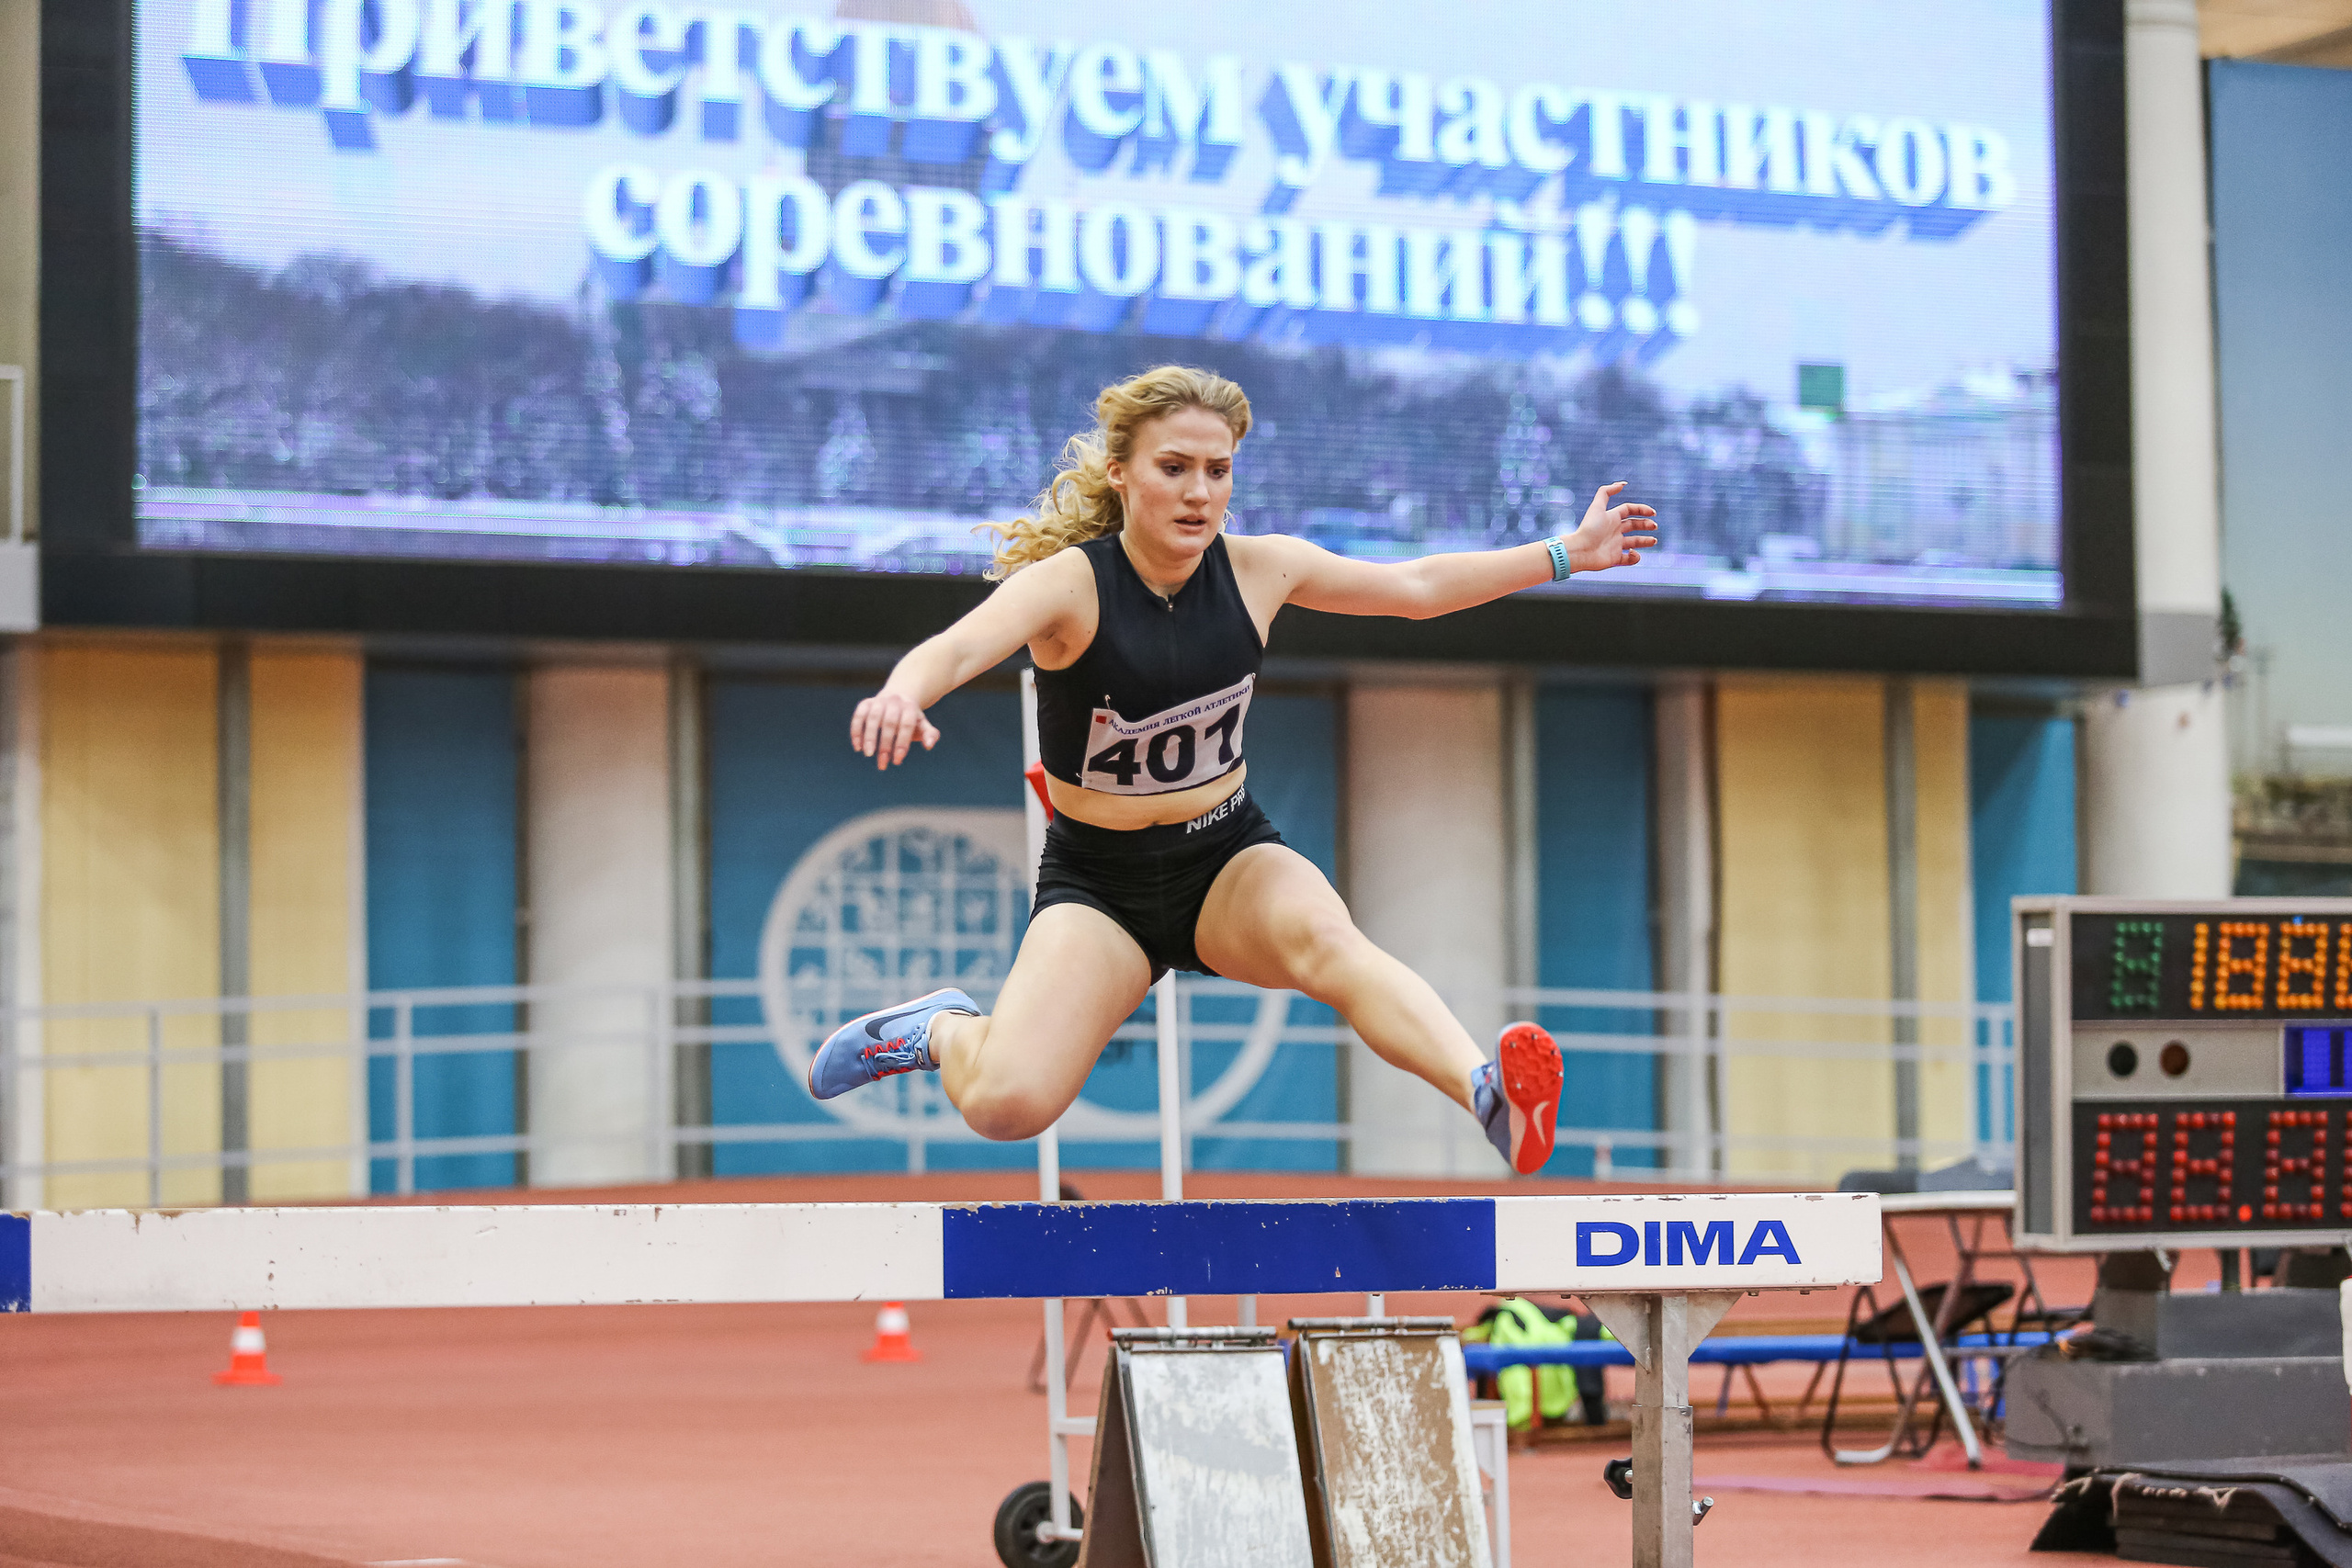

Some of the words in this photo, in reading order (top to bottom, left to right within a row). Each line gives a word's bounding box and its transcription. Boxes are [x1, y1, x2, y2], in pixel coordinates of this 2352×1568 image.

[1271, 57, 2014, 213] участников
[584, 164, 1699, 340] соревнований!!!
[1087, 703, 1240, 785] 401
[1108, 718, 1160, 736] АКАДЕМИЯ
[1162, 705, 1202, 726] ЛЕГКОЙ
[1186, 801, 1229, 834] NIKE
[1576, 1220, 1802, 1267] DIMA
